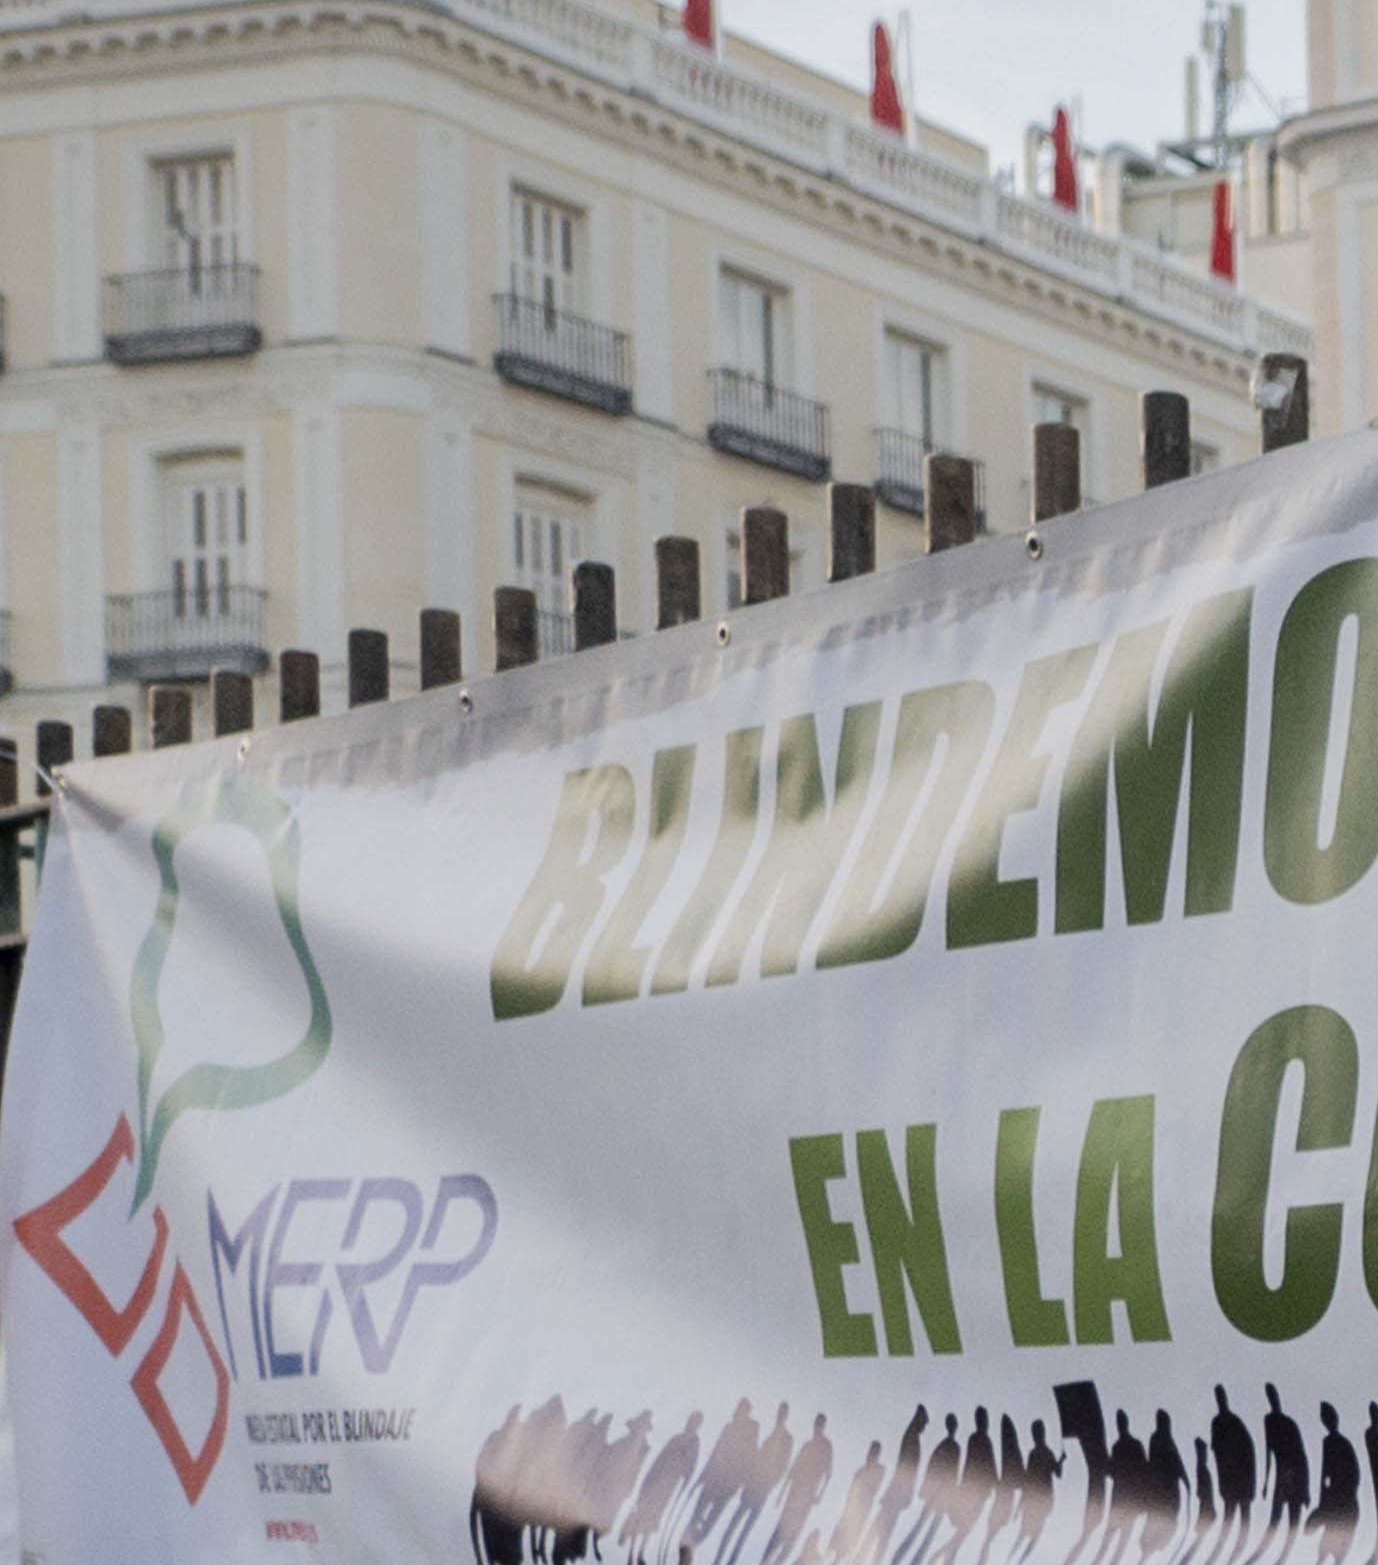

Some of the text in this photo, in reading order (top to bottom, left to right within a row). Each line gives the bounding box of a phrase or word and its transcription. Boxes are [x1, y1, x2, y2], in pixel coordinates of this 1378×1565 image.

[207, 1173, 499, 1382] MERP
[788, 1122, 963, 1359] EN
[994, 1093, 1173, 1348] LA
